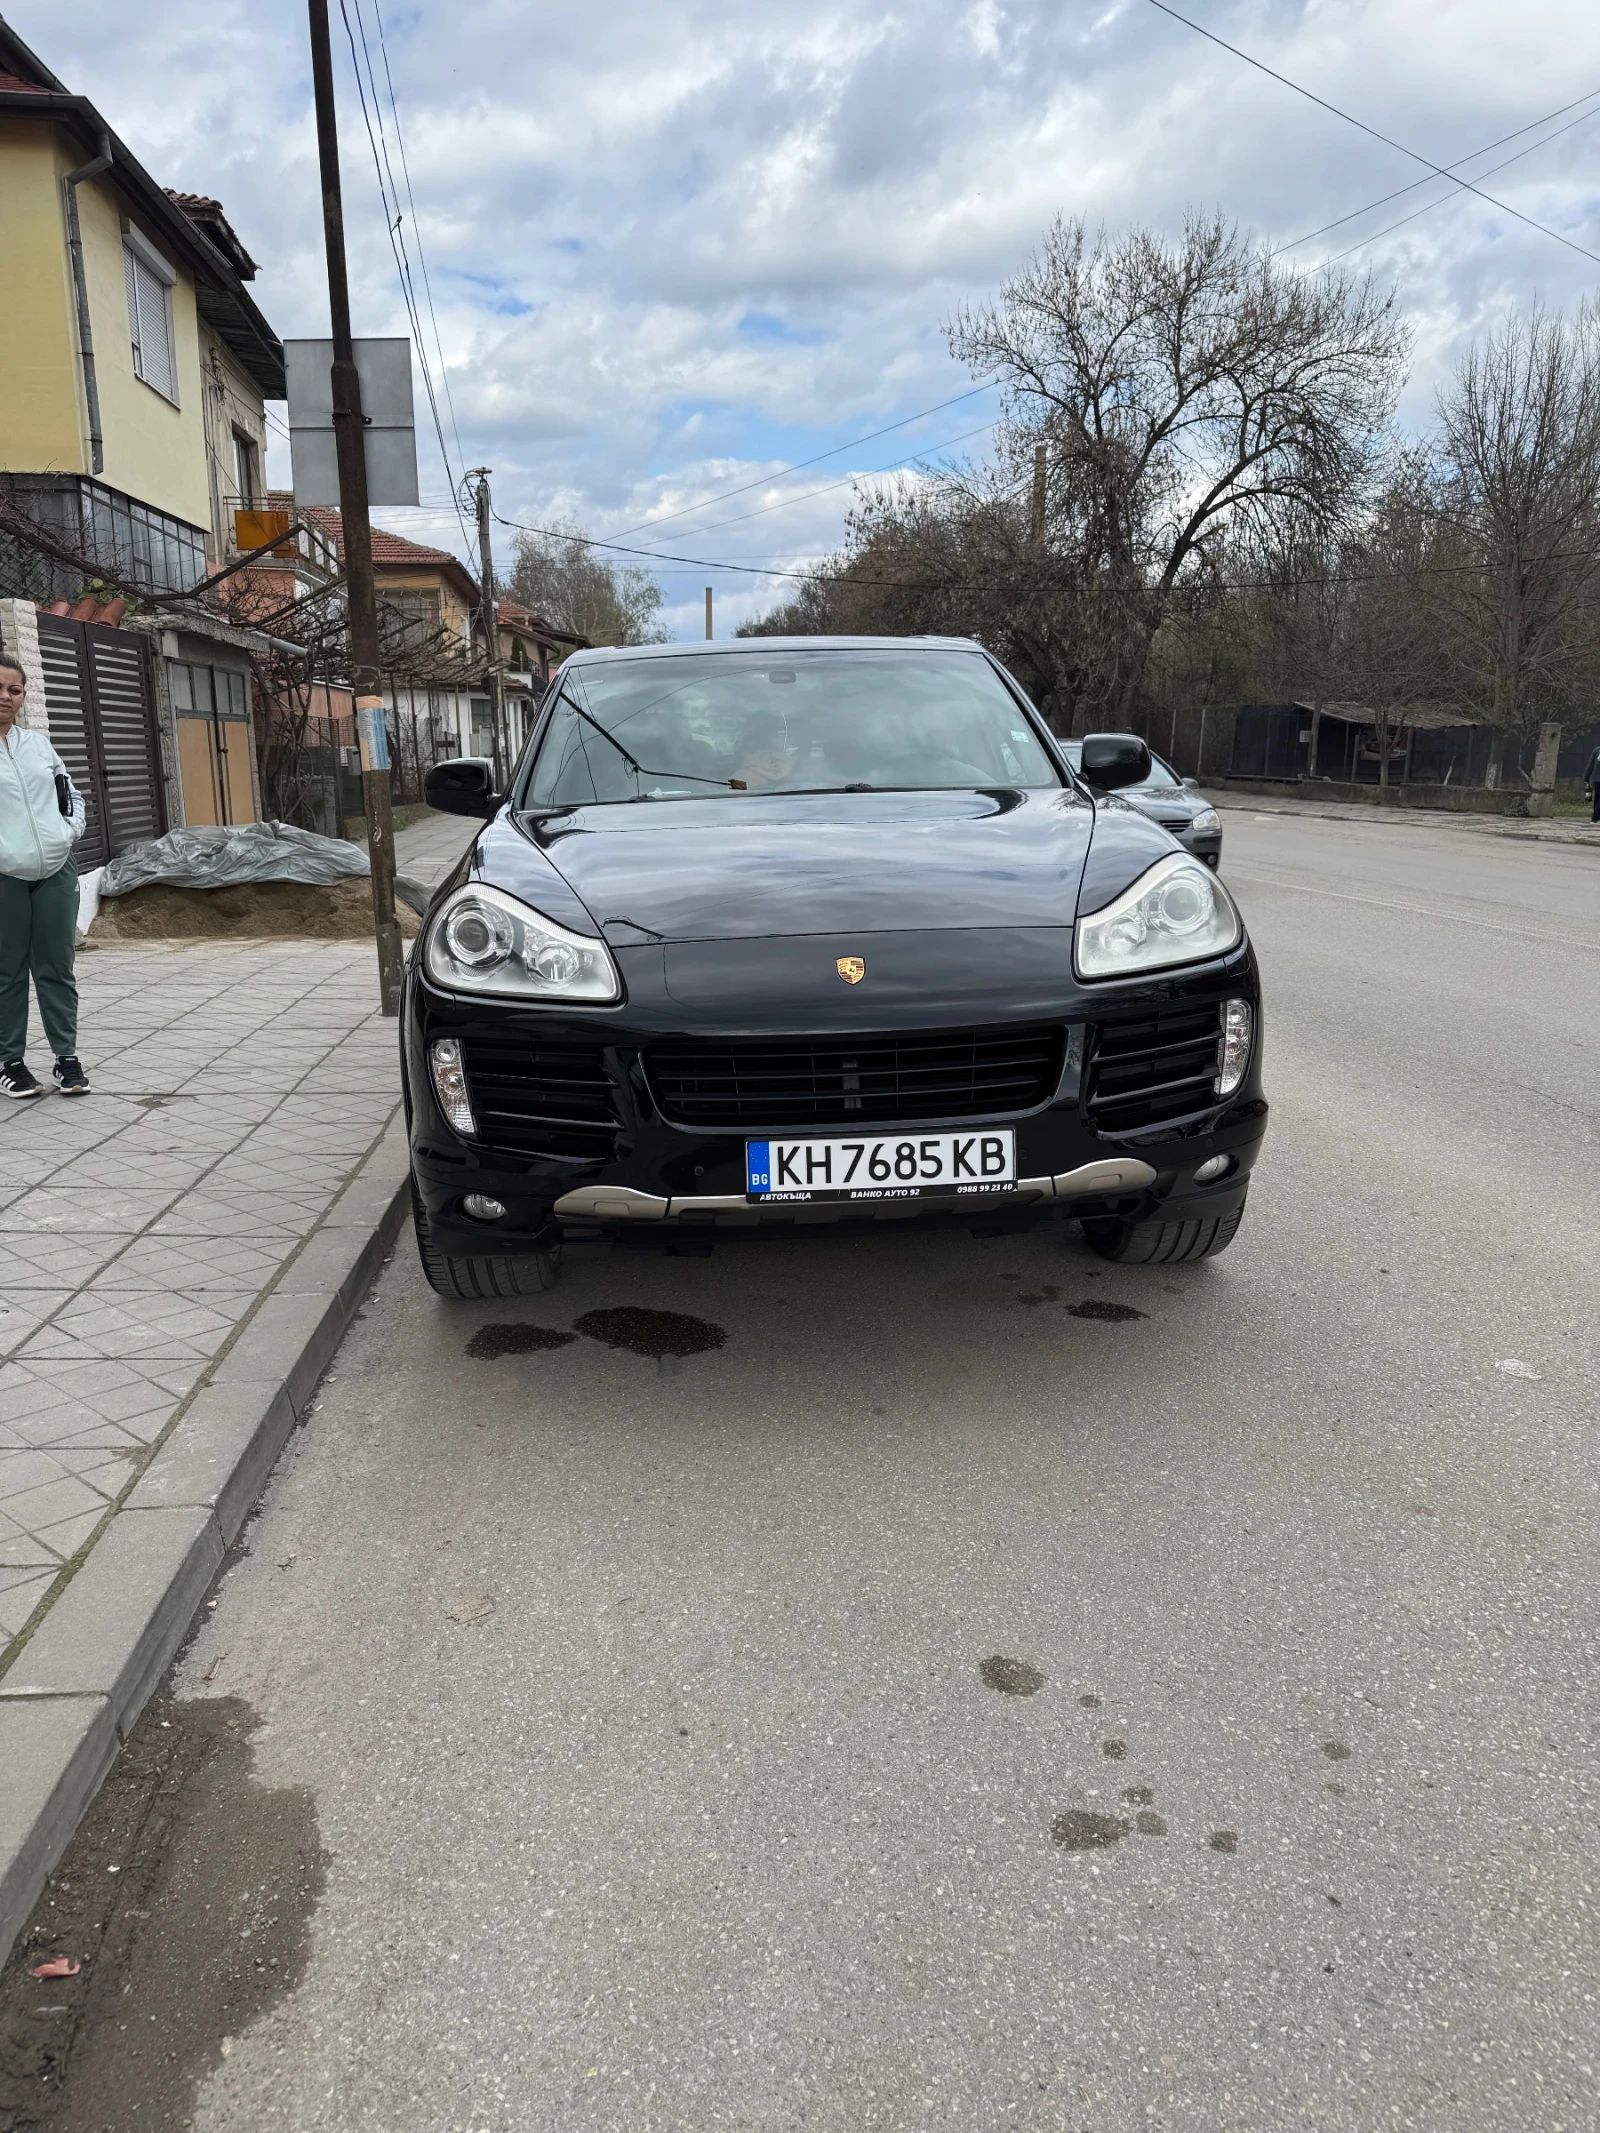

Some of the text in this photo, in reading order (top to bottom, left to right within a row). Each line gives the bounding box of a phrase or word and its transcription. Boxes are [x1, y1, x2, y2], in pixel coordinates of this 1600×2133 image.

[751, 1173, 768, 1186] BG
[850, 1188, 920, 1199] ВАНКО АУТО 92
[957, 1183, 1014, 1194] 0988 99 23 40
[759, 1192, 812, 1202] АВТОКЪЩА
